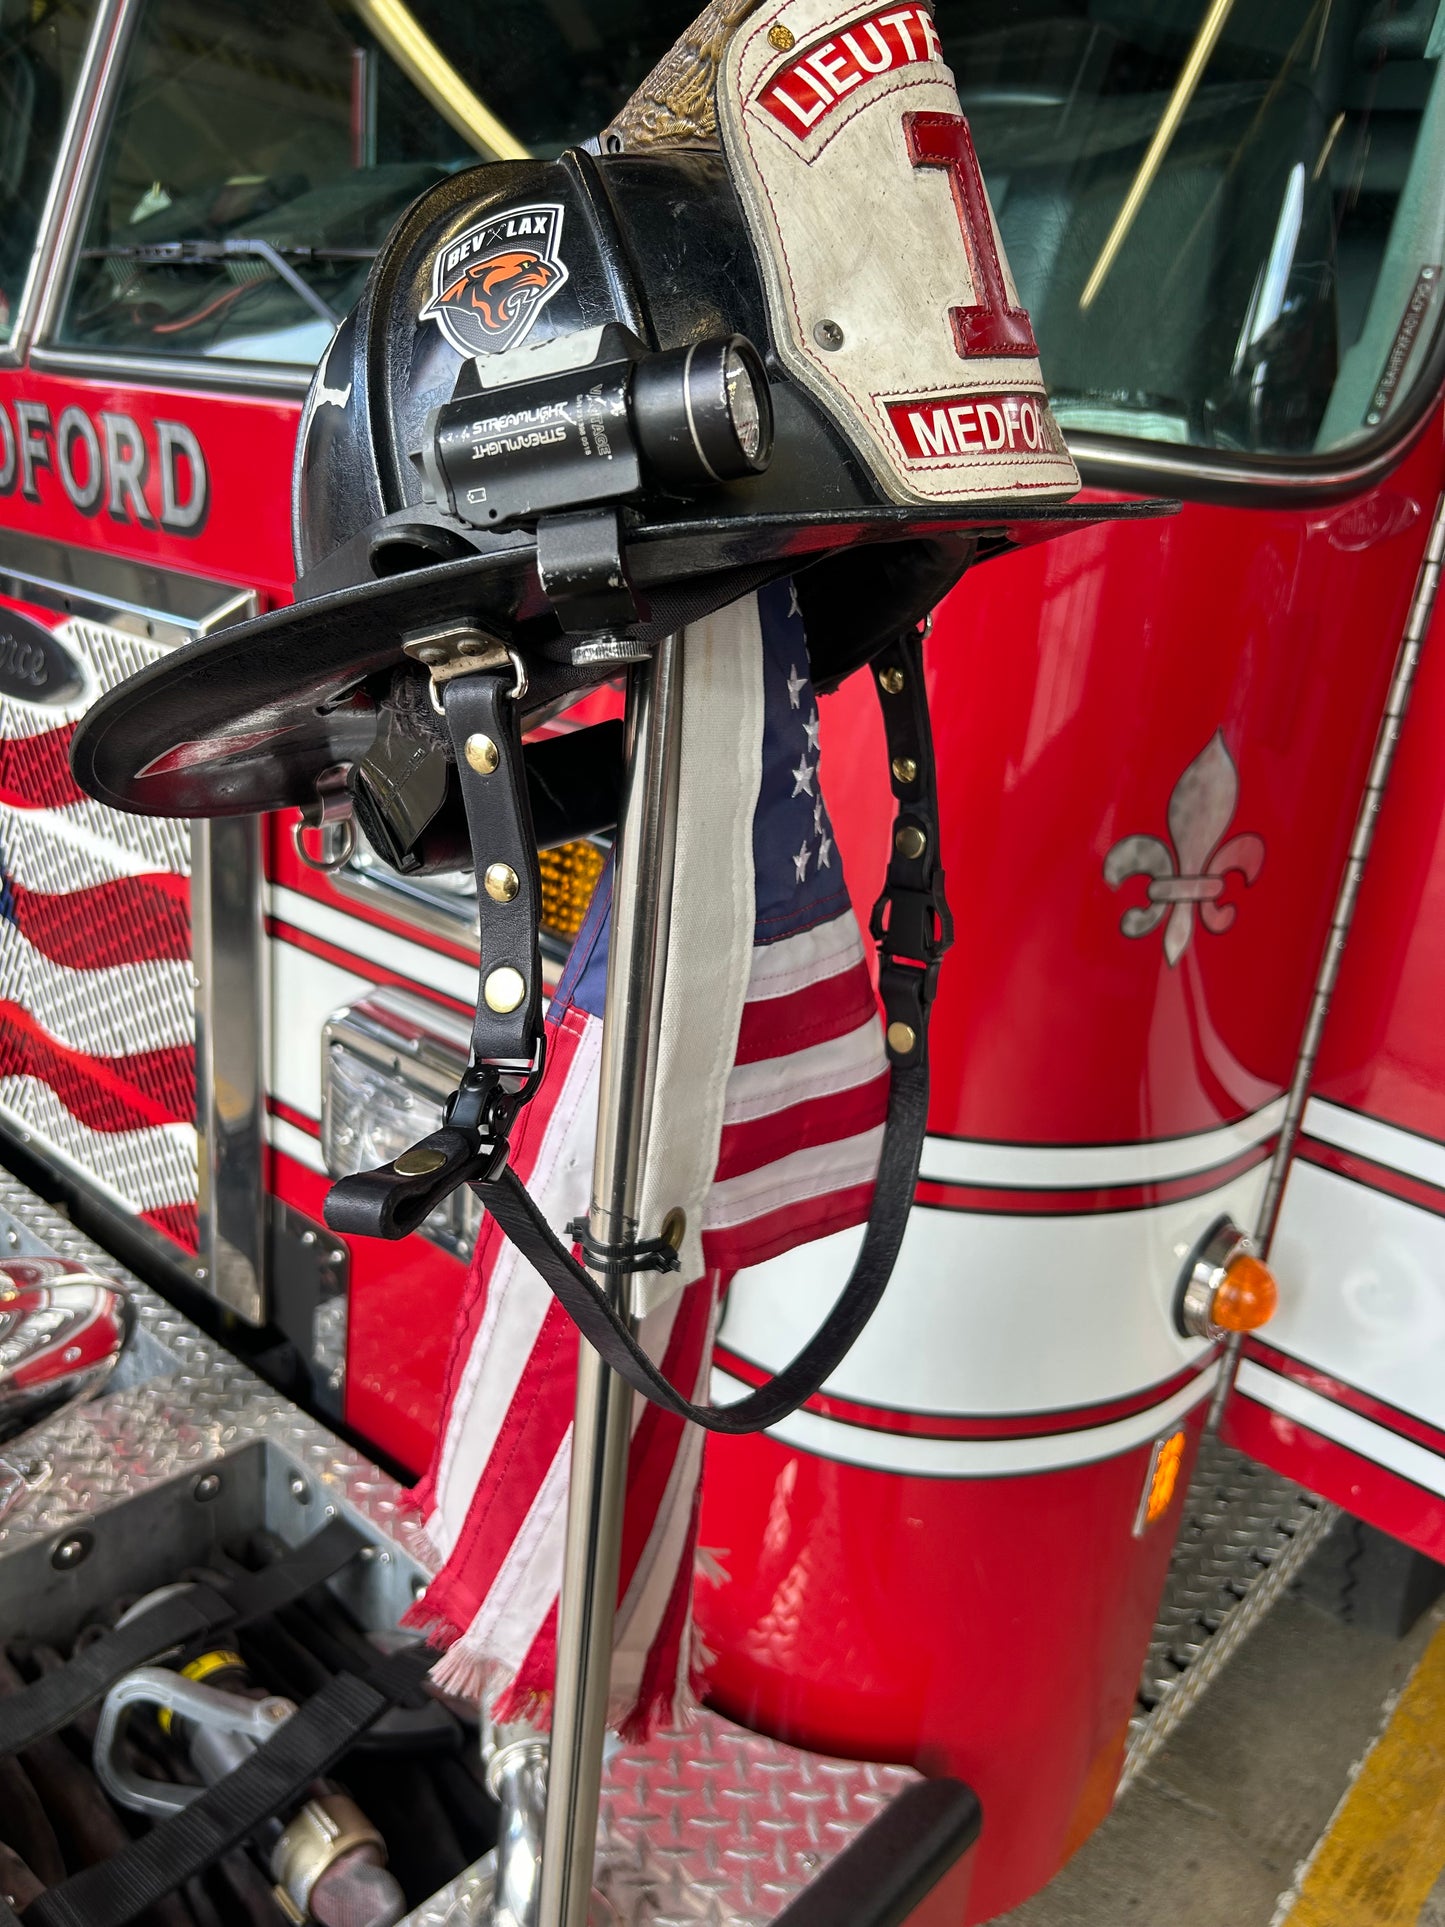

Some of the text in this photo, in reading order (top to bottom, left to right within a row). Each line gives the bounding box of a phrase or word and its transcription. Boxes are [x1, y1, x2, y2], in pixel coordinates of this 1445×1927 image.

[446, 215, 549, 271] BEV LAX
[471, 401, 569, 436] STREAMLIGHT
[471, 426, 567, 460] STREAMLIGHT
